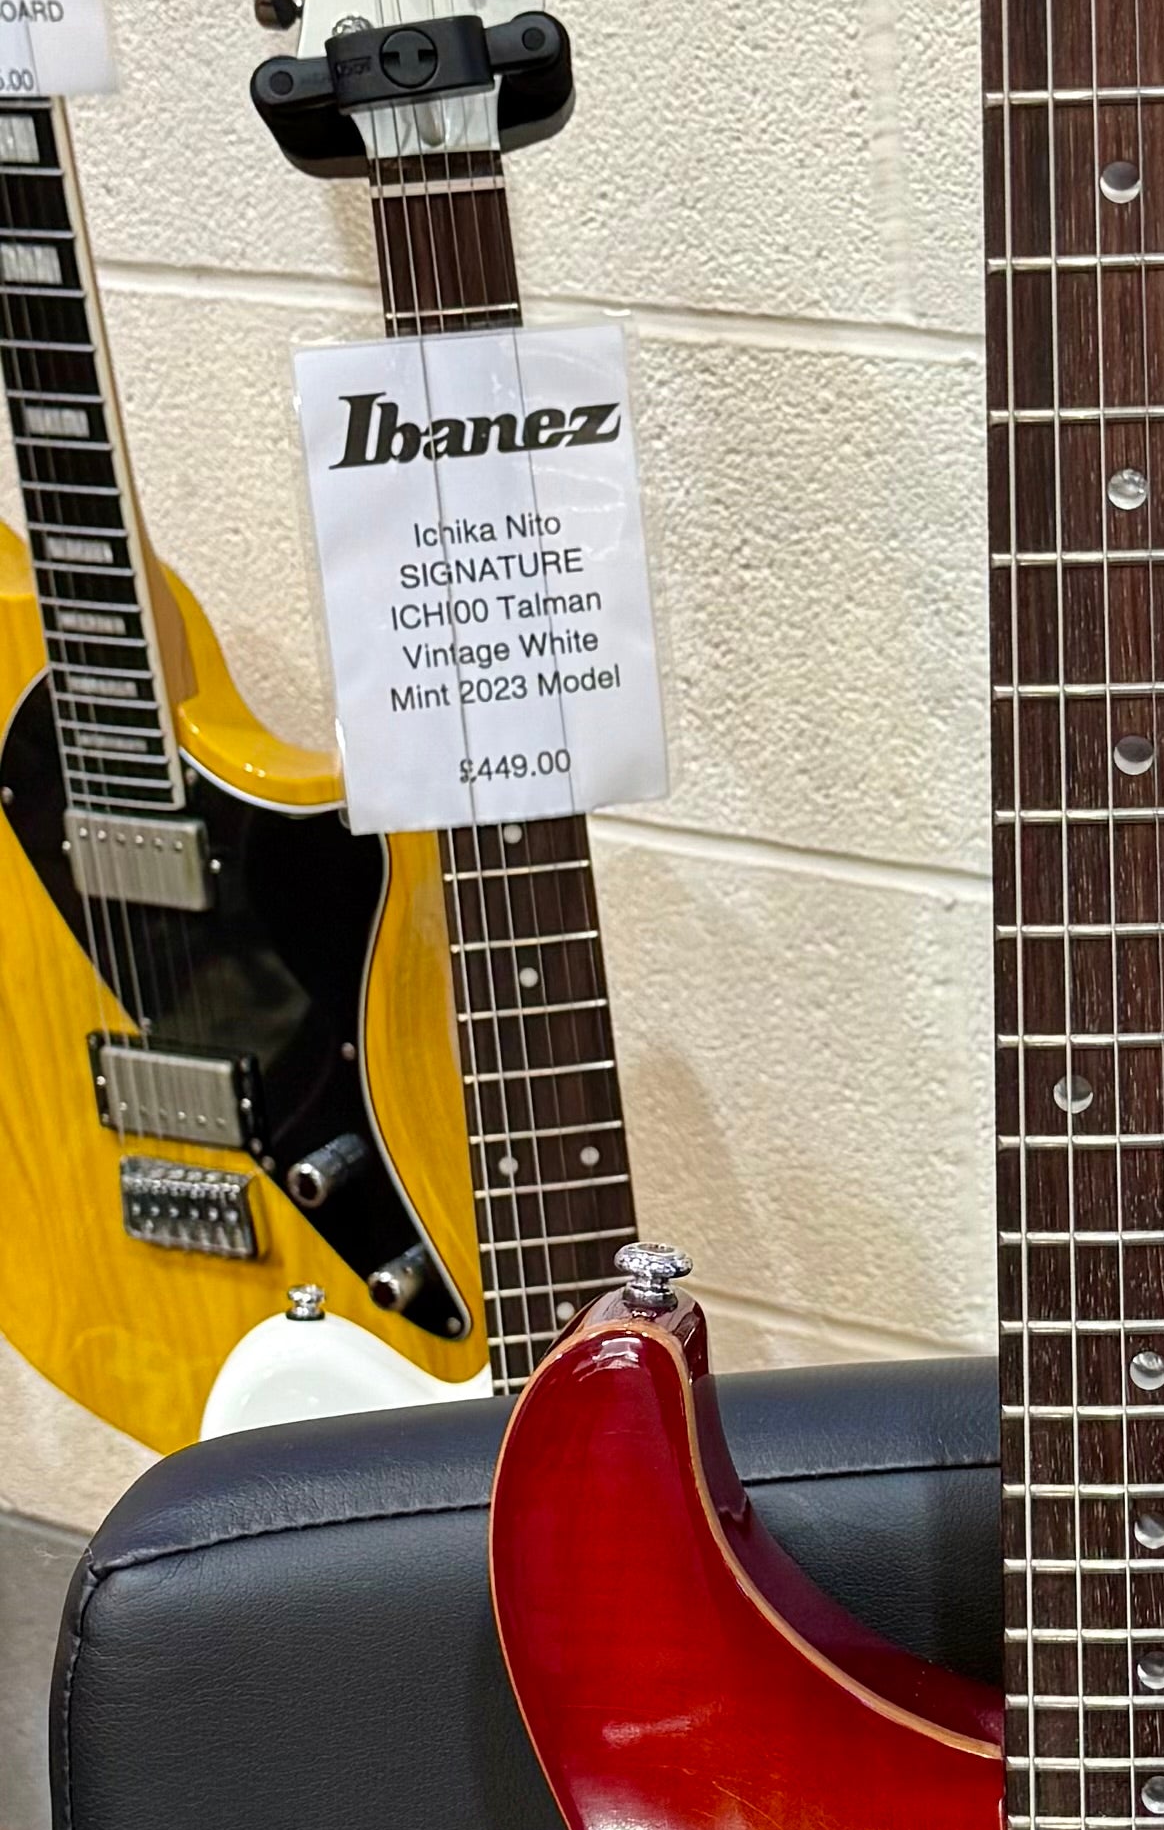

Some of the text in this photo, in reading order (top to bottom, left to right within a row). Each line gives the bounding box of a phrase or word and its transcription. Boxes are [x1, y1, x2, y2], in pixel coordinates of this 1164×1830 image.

[0, 0, 65, 22] OARD
[328, 391, 622, 471] Ibanez
[413, 512, 561, 549] Ichika Nito
[399, 547, 584, 590] SIGNATURE
[496, 591, 602, 621] Talman
[402, 629, 599, 670] Vintage White
[390, 663, 622, 712] Mint 2023 Model
[459, 748, 572, 784] £449.00
